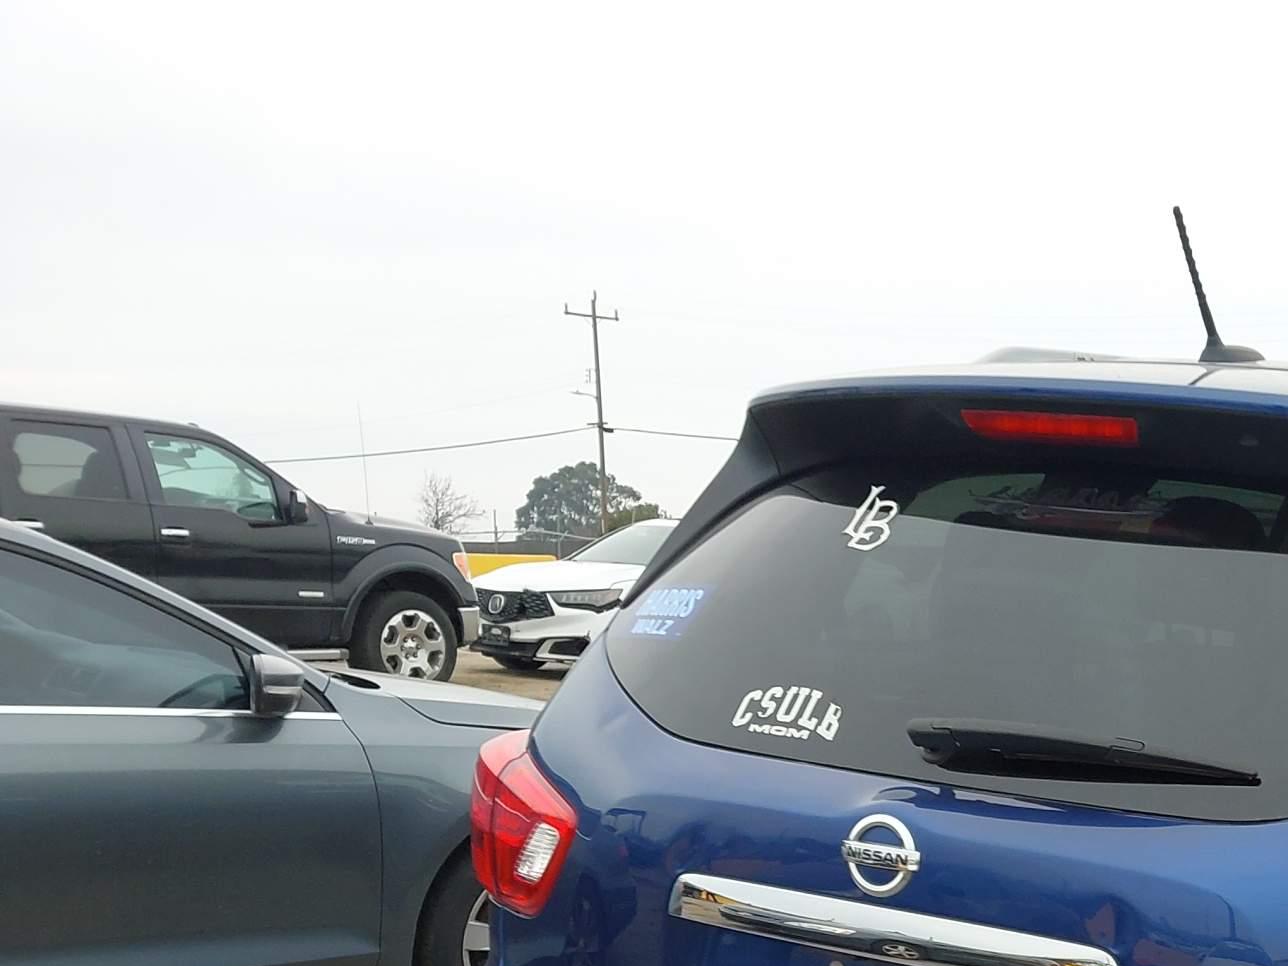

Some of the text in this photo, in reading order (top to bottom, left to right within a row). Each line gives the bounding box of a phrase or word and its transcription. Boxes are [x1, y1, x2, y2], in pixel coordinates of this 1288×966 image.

[731, 685, 843, 741] CSULB
[747, 723, 811, 740] MOM
[846, 845, 910, 867] NISSAN
